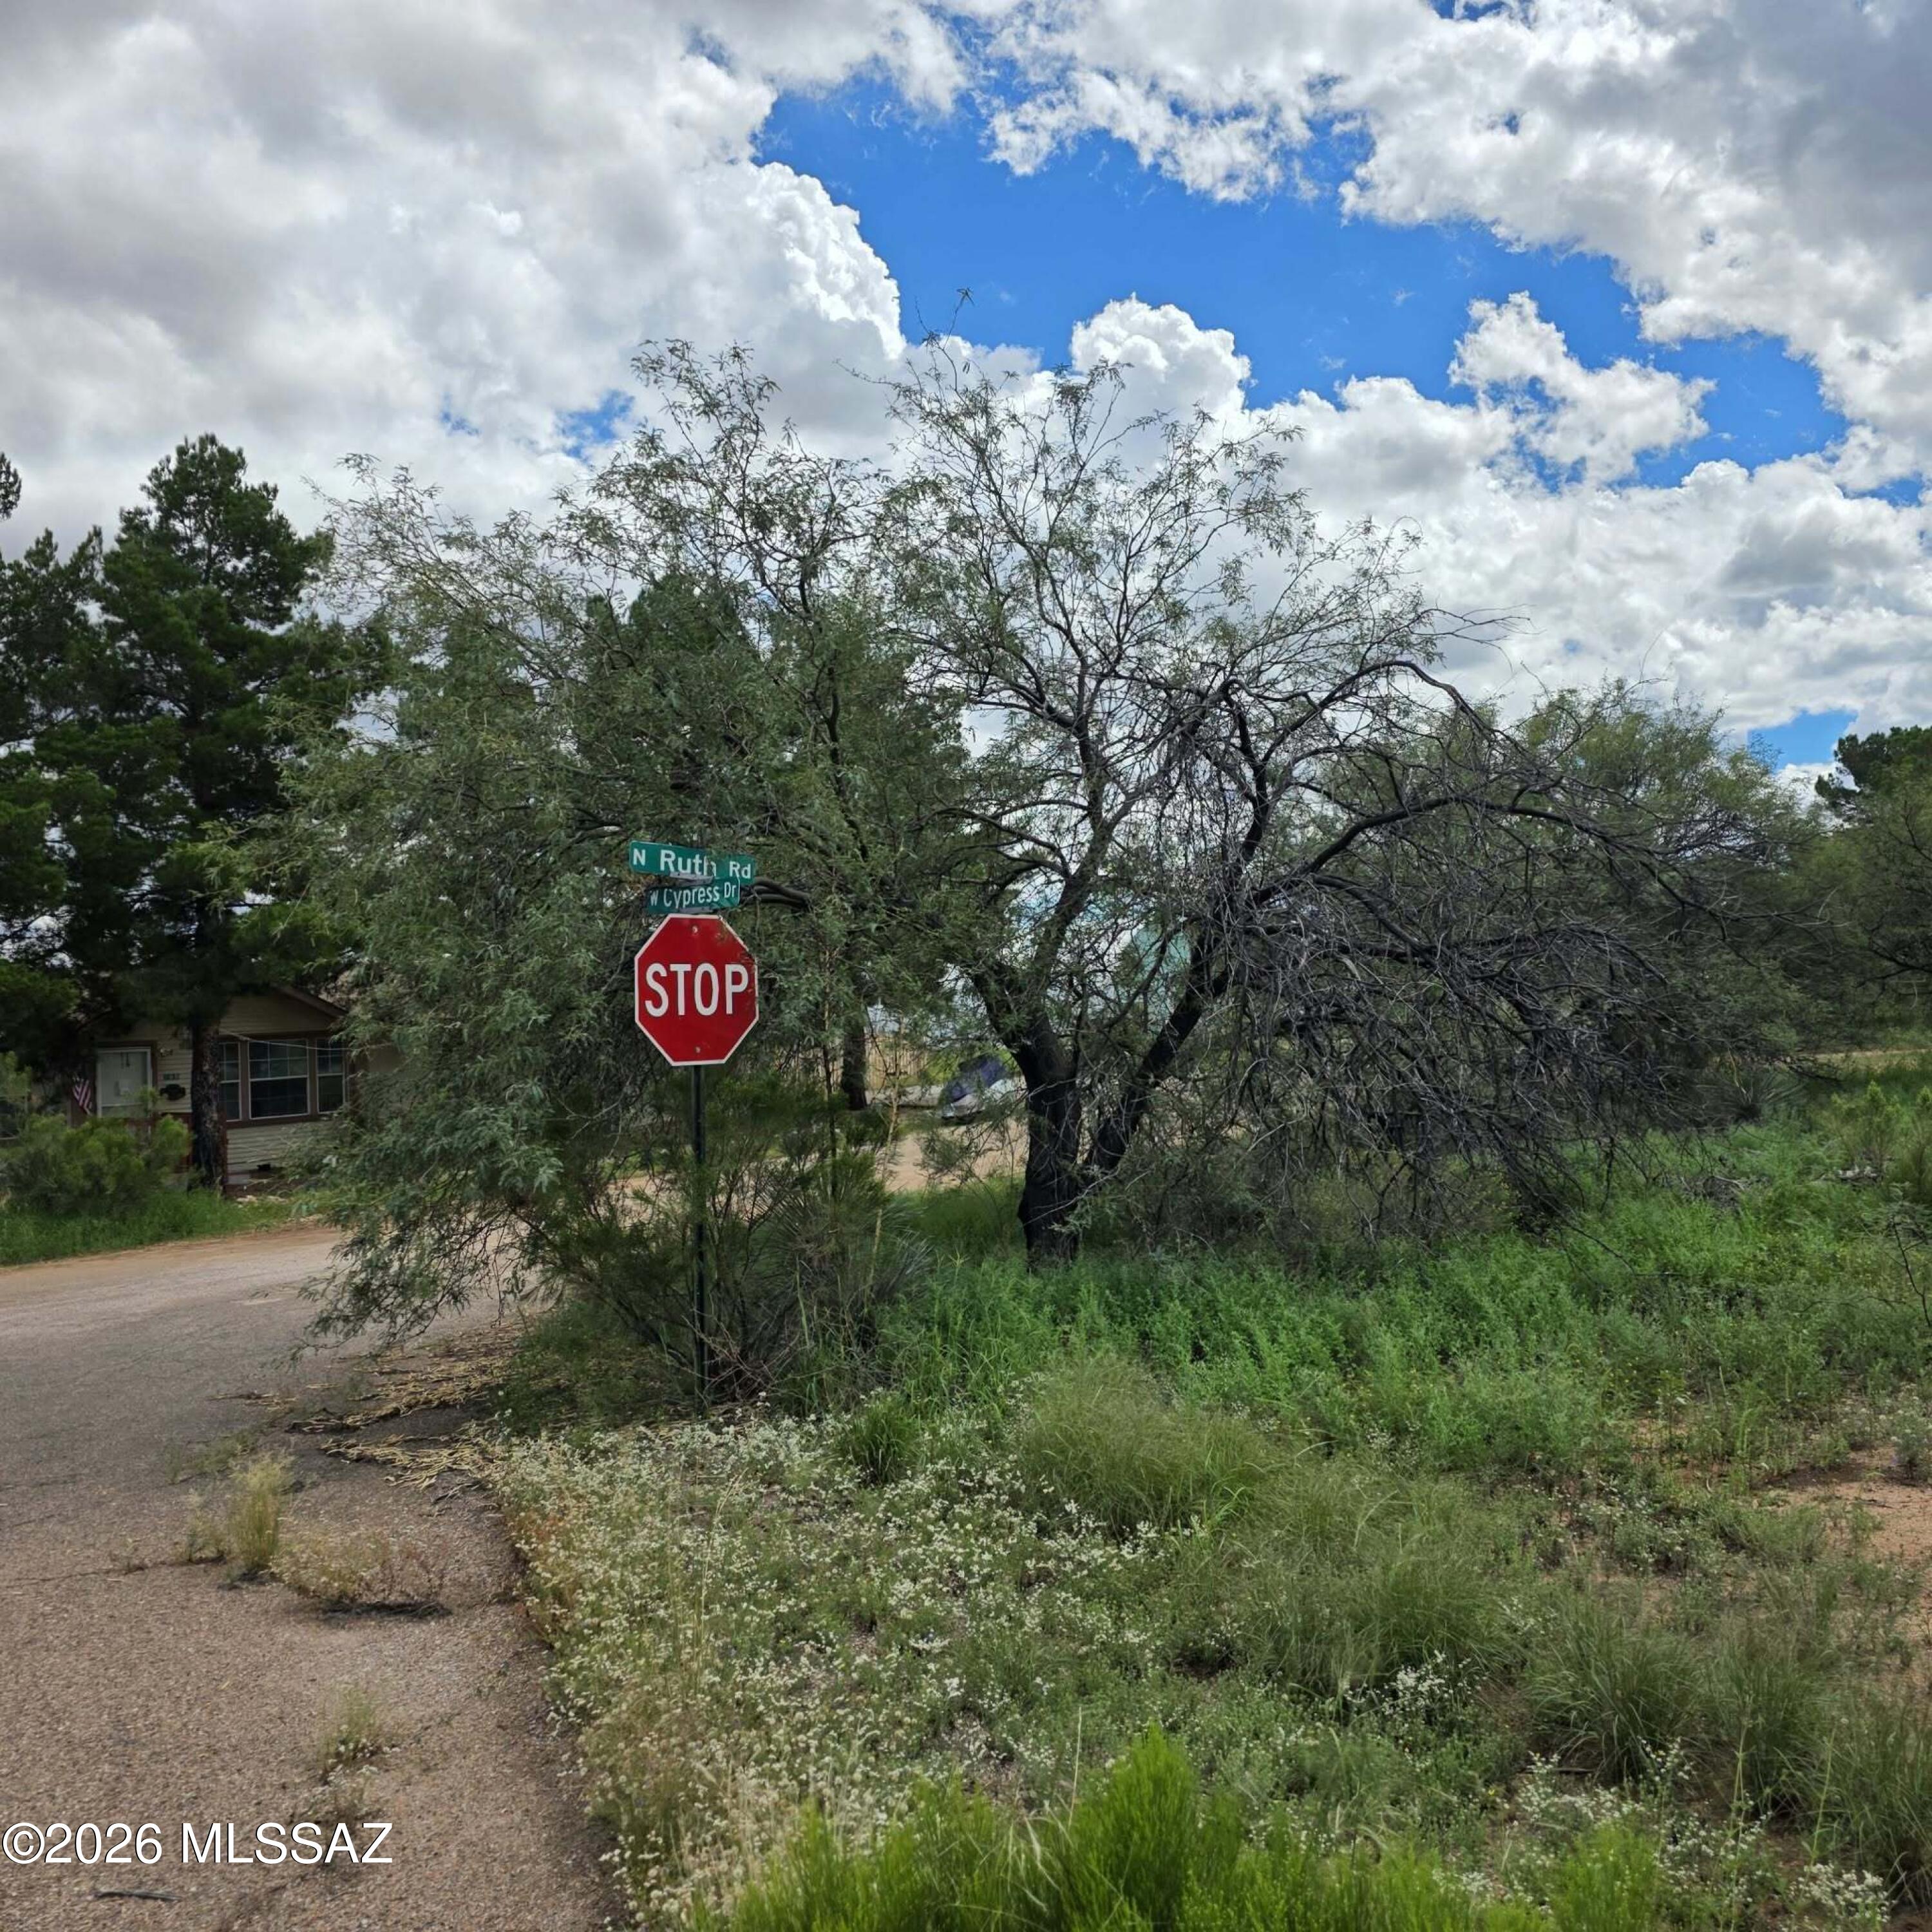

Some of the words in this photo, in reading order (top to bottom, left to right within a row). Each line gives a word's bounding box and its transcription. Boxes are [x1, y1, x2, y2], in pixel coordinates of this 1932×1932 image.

[632, 848, 647, 866] N
[659, 849, 717, 876] Ruth
[728, 860, 751, 879] Rd
[649, 890, 659, 907] W
[663, 886, 720, 909] Cypress
[724, 882, 737, 898] Dr
[645, 963, 749, 1018] STOP
